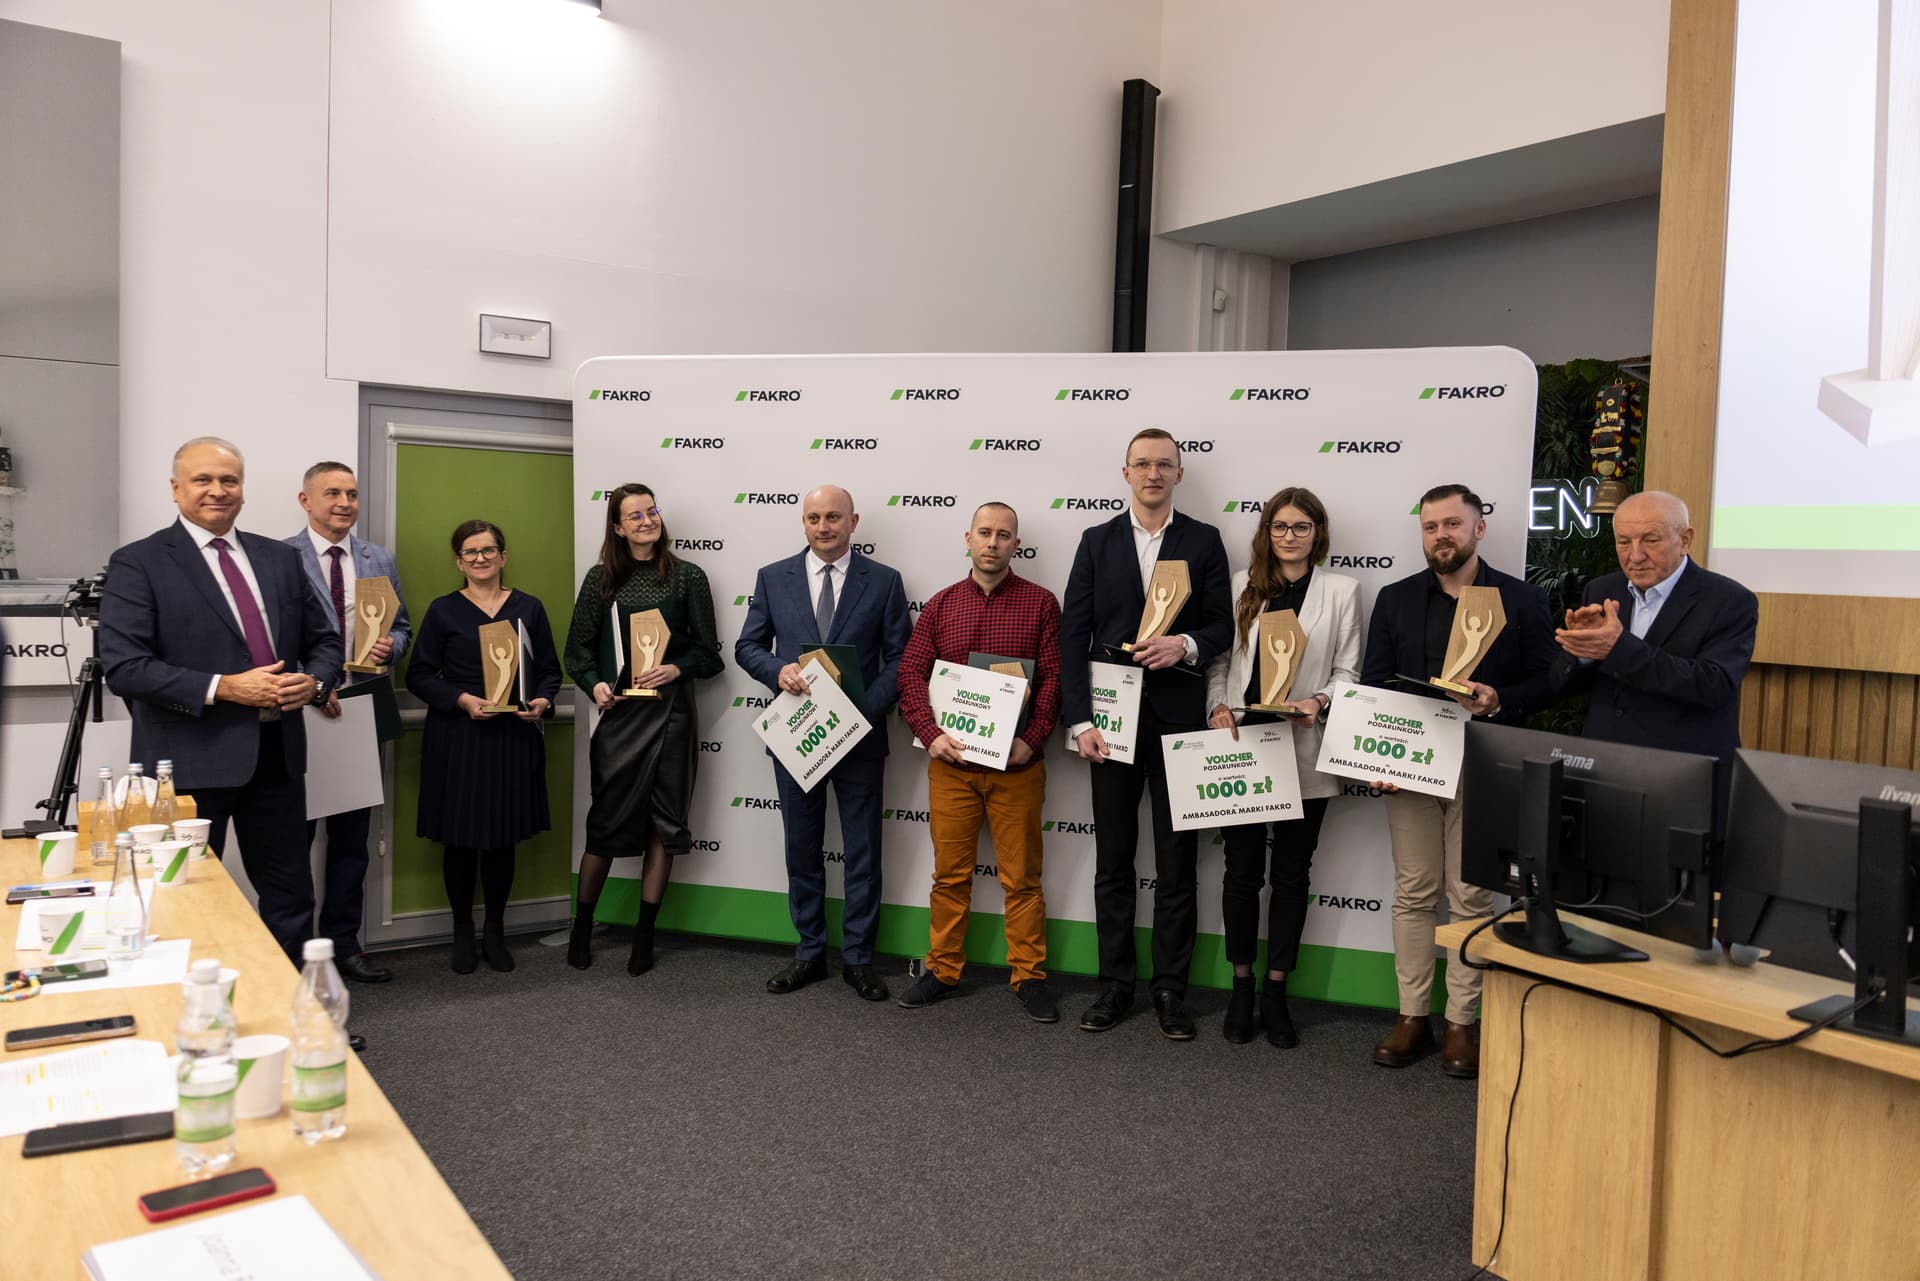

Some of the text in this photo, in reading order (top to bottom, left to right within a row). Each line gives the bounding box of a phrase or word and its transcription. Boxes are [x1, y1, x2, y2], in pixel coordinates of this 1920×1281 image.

[602, 390, 650, 402] FAKRO
[750, 390, 800, 402] FAKRO
[905, 388, 959, 401] FAKRO
[1071, 389, 1129, 401] FAKRO
[1247, 388, 1308, 401] FAKRO
[1438, 385, 1504, 400] FAKRO
[674, 437, 723, 449] FAKRO
[825, 438, 876, 450] FAKRO
[985, 439, 1040, 451] FAKRO
[1177, 441, 1213, 452] KRO
[1337, 441, 1400, 454] FAKRO
[748, 492, 798, 505] FAKRO
[902, 495, 955, 508] FAKRO
[1066, 497, 1124, 511] FAKRO
[674, 539, 722, 551] FAKRO
[1330, 554, 1392, 569] FAKRO
[4, 644, 68, 658] AKRO
[747, 697, 773, 709] FAK
[957, 689, 991, 704] VOUCHER
[786, 699, 814, 727] VOUCHER
[940, 711, 996, 739] 1000 zł
[1093, 713, 1109, 730] 00
[1373, 712, 1423, 730] VOUCHER
[795, 725, 827, 758] 1000
[826, 710, 841, 731] zł
[844, 722, 860, 740] FAKRO
[1367, 720, 1426, 736] PODARUNKOWY
[981, 748, 1000, 759] FAKRO
[1353, 735, 1435, 765] 1000 zł
[1205, 752, 1254, 765] VOUCHER
[1203, 760, 1258, 772] PODARUNKOWY
[1329, 757, 1446, 787] AMBASADORA MARKI FAKRO
[1196, 776, 1273, 800] 1000 zł
[1343, 784, 1383, 798] KRO
[745, 797, 782, 810] FAKR
[1182, 808, 1237, 820] AMBASADORA
[1238, 805, 1264, 815] MARKI
[1265, 802, 1292, 813] FAKRO
[690, 840, 720, 851] KRO
[1319, 895, 1381, 912] FAKRO
